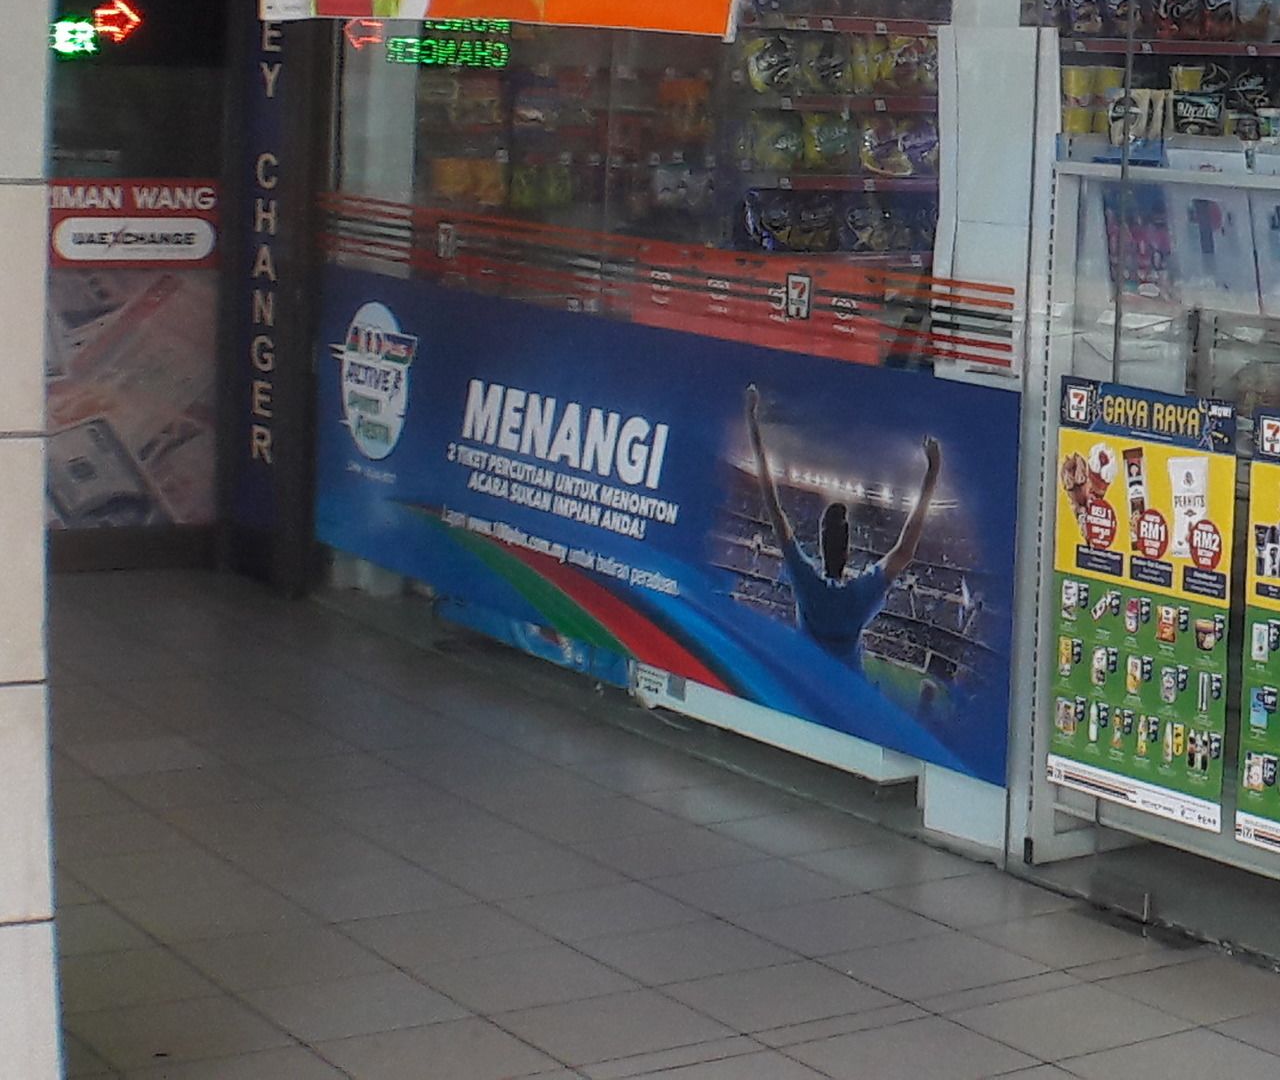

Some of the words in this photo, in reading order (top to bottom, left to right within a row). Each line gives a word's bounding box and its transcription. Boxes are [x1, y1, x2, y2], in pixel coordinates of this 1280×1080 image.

[133, 186, 217, 211] WANG
[251, 152, 280, 464] CHANGER
[462, 378, 670, 490] MENANGI
[1103, 395, 1148, 429] GAYA
[1153, 402, 1200, 436] RAYA
[467, 470, 509, 499] ACARA
[509, 482, 554, 512] SUKAN
[552, 497, 601, 528] IMPIAN
[600, 510, 648, 541] ANDA!
[488, 454, 554, 489] PERCUTIAN
[555, 474, 599, 501] UNTUK
[600, 485, 679, 525] MENONTON
[1139, 521, 1165, 542] RM1
[1193, 530, 1220, 551] RM2
